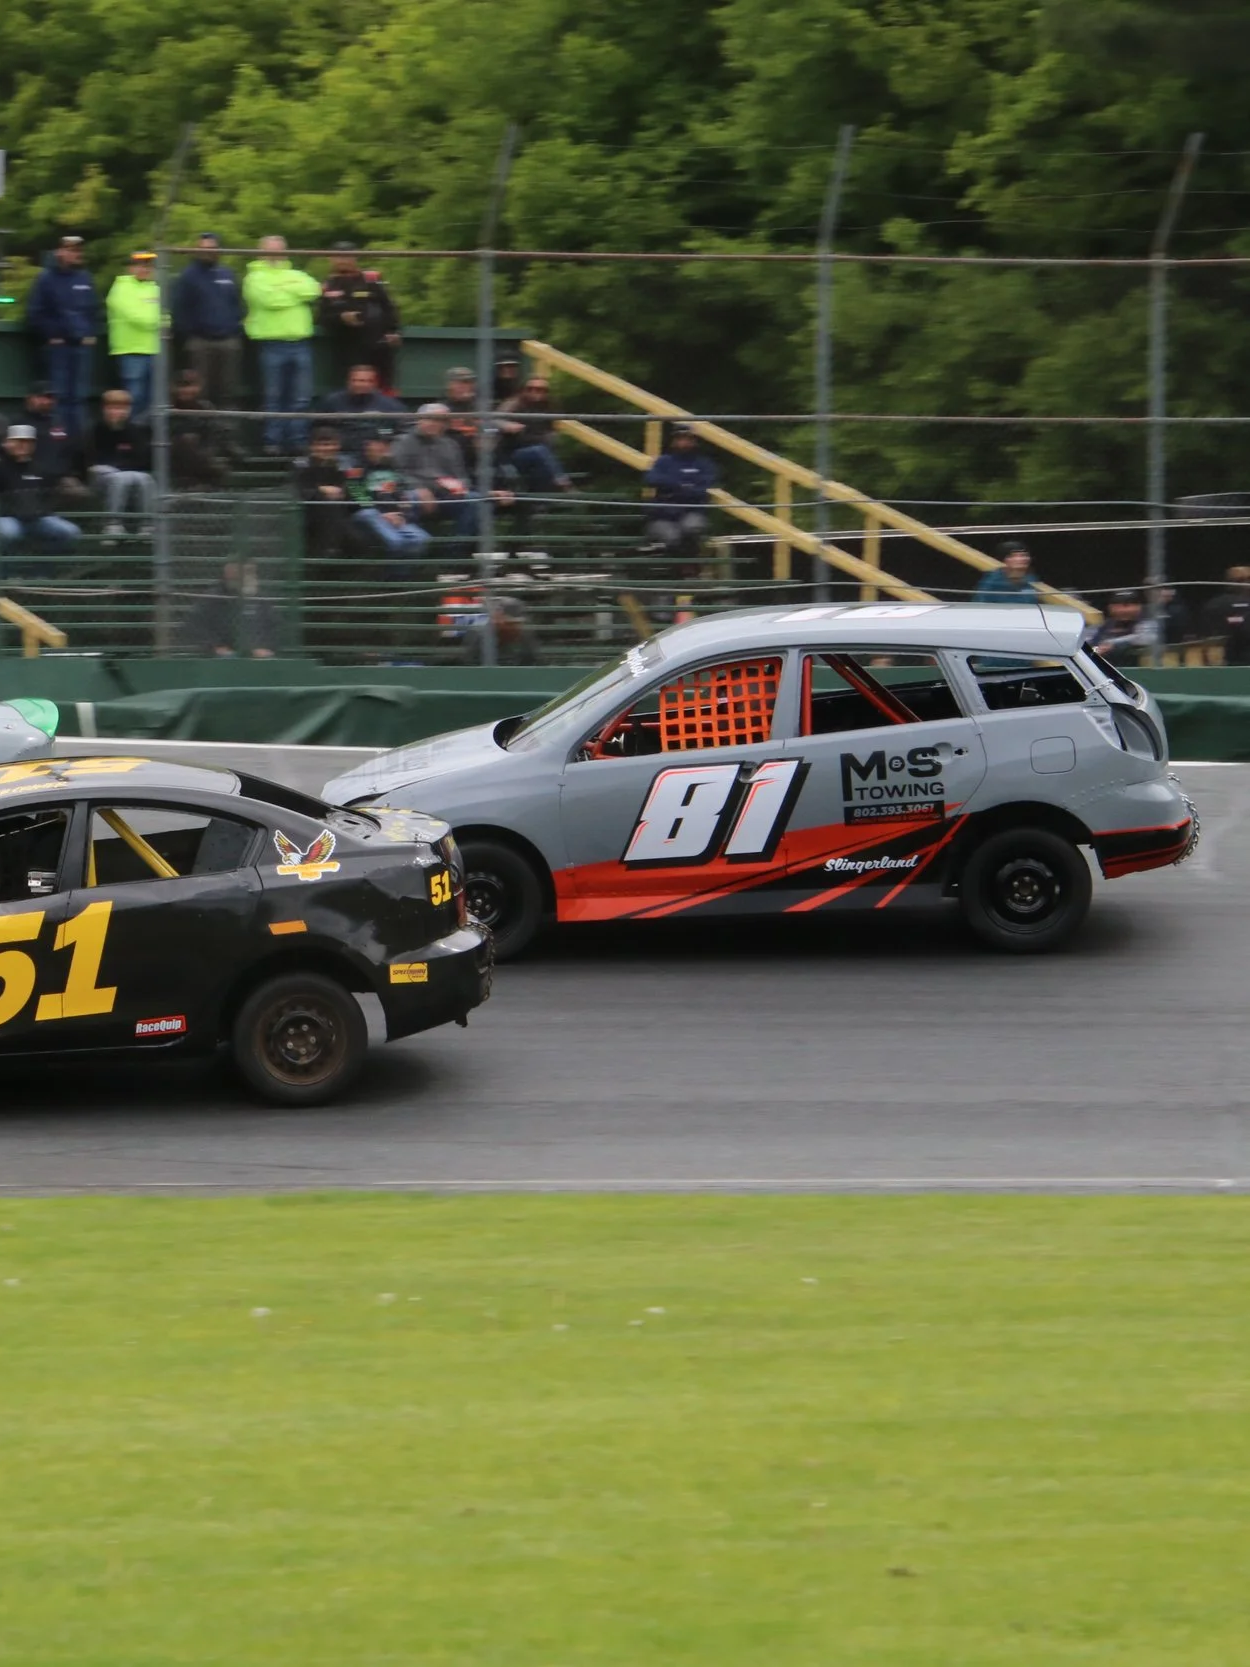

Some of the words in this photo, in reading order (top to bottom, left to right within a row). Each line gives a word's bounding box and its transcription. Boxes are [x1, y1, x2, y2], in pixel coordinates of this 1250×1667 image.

[854, 782, 945, 801] TOWING
[620, 758, 806, 866] 81
[853, 803, 935, 818] 802.393.3061
[824, 855, 919, 874] Slingerland
[429, 870, 452, 906] 51
[136, 1019, 182, 1034] RaceQuip
